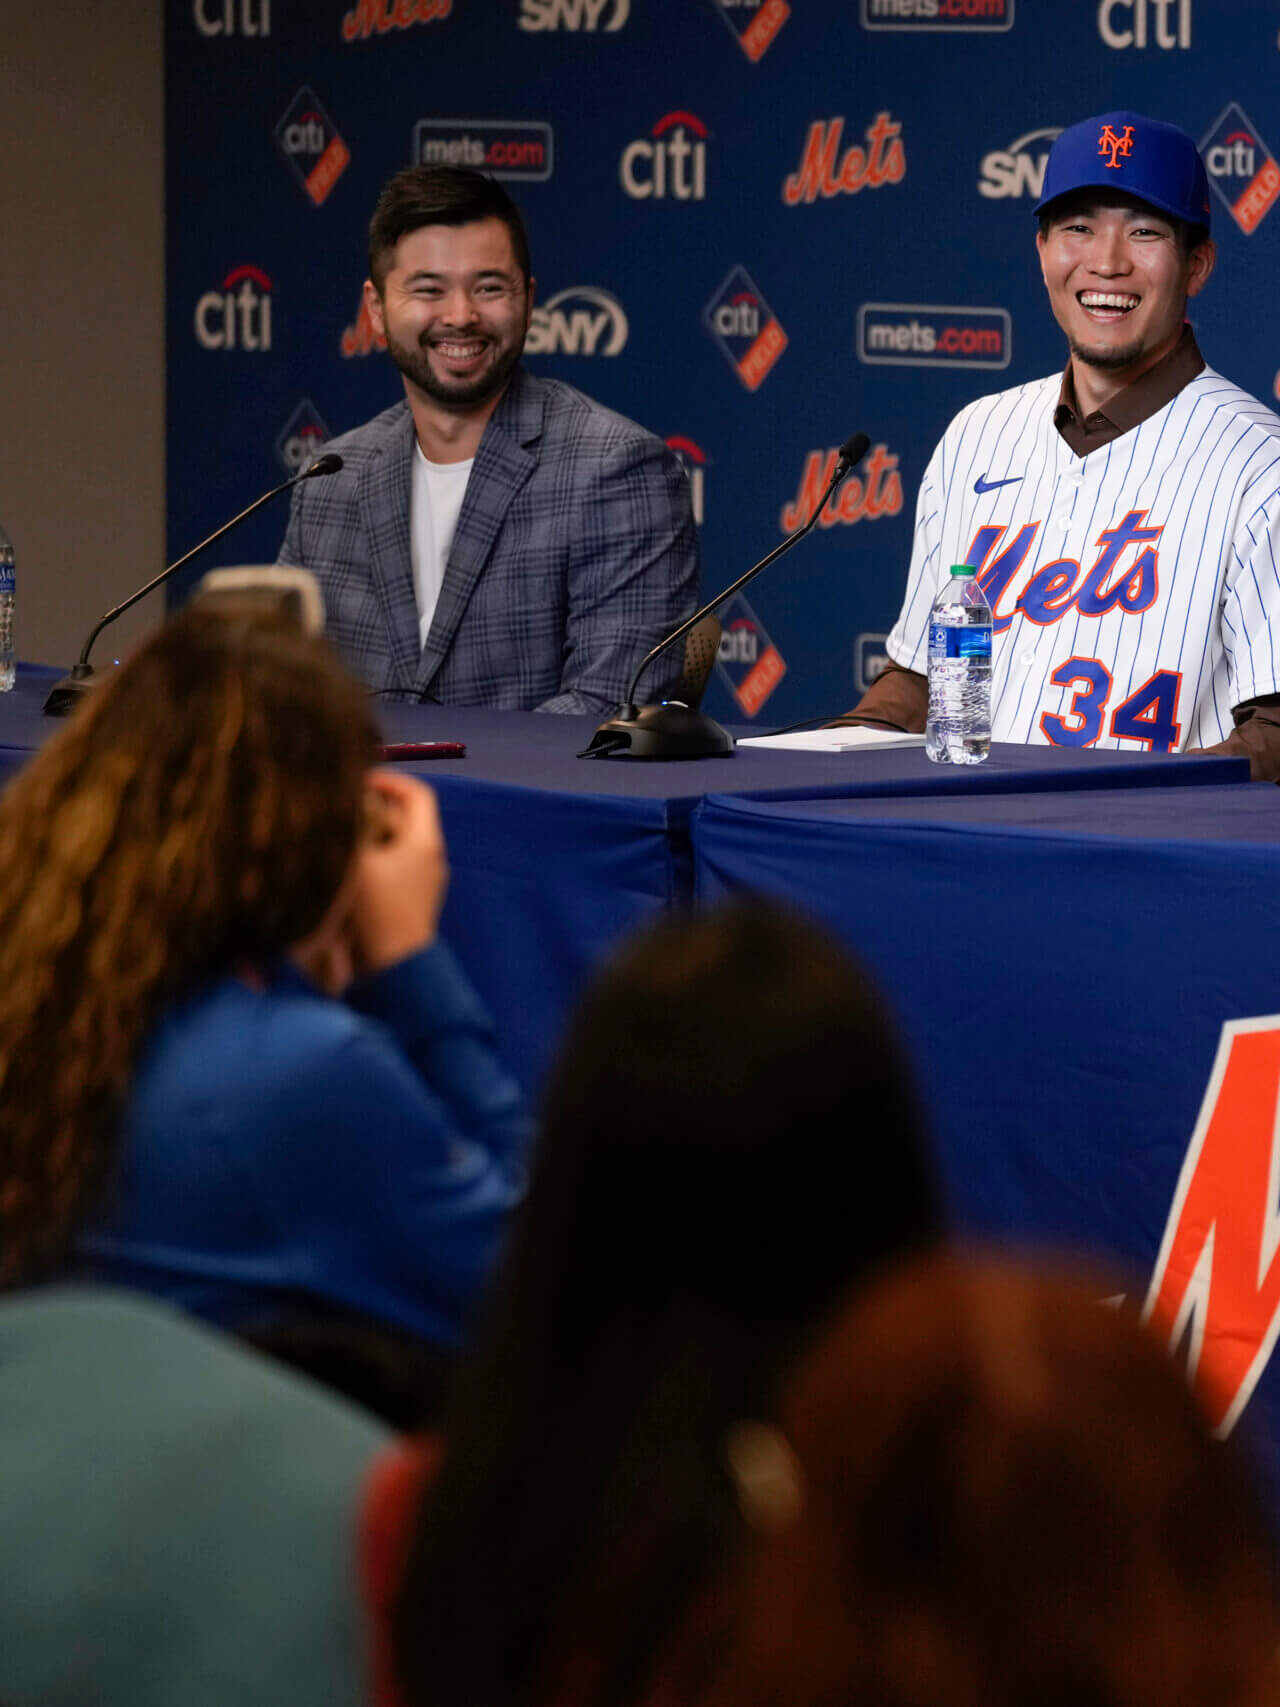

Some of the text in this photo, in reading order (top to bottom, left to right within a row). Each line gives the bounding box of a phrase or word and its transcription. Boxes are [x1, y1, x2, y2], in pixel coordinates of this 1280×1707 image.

[1098, 0, 1191, 48] citi
[424, 137, 543, 165] mets.com
[621, 121, 706, 199] citi
[783, 112, 905, 205] Mets
[979, 150, 1048, 198] SN
[1207, 139, 1254, 177] citi
[195, 279, 271, 351] citi
[715, 302, 758, 336] citi
[868, 321, 1001, 353] mets.com
[781, 444, 903, 534] Mets
[964, 509, 1165, 636] Mets
[1039, 655, 1183, 754] 34
